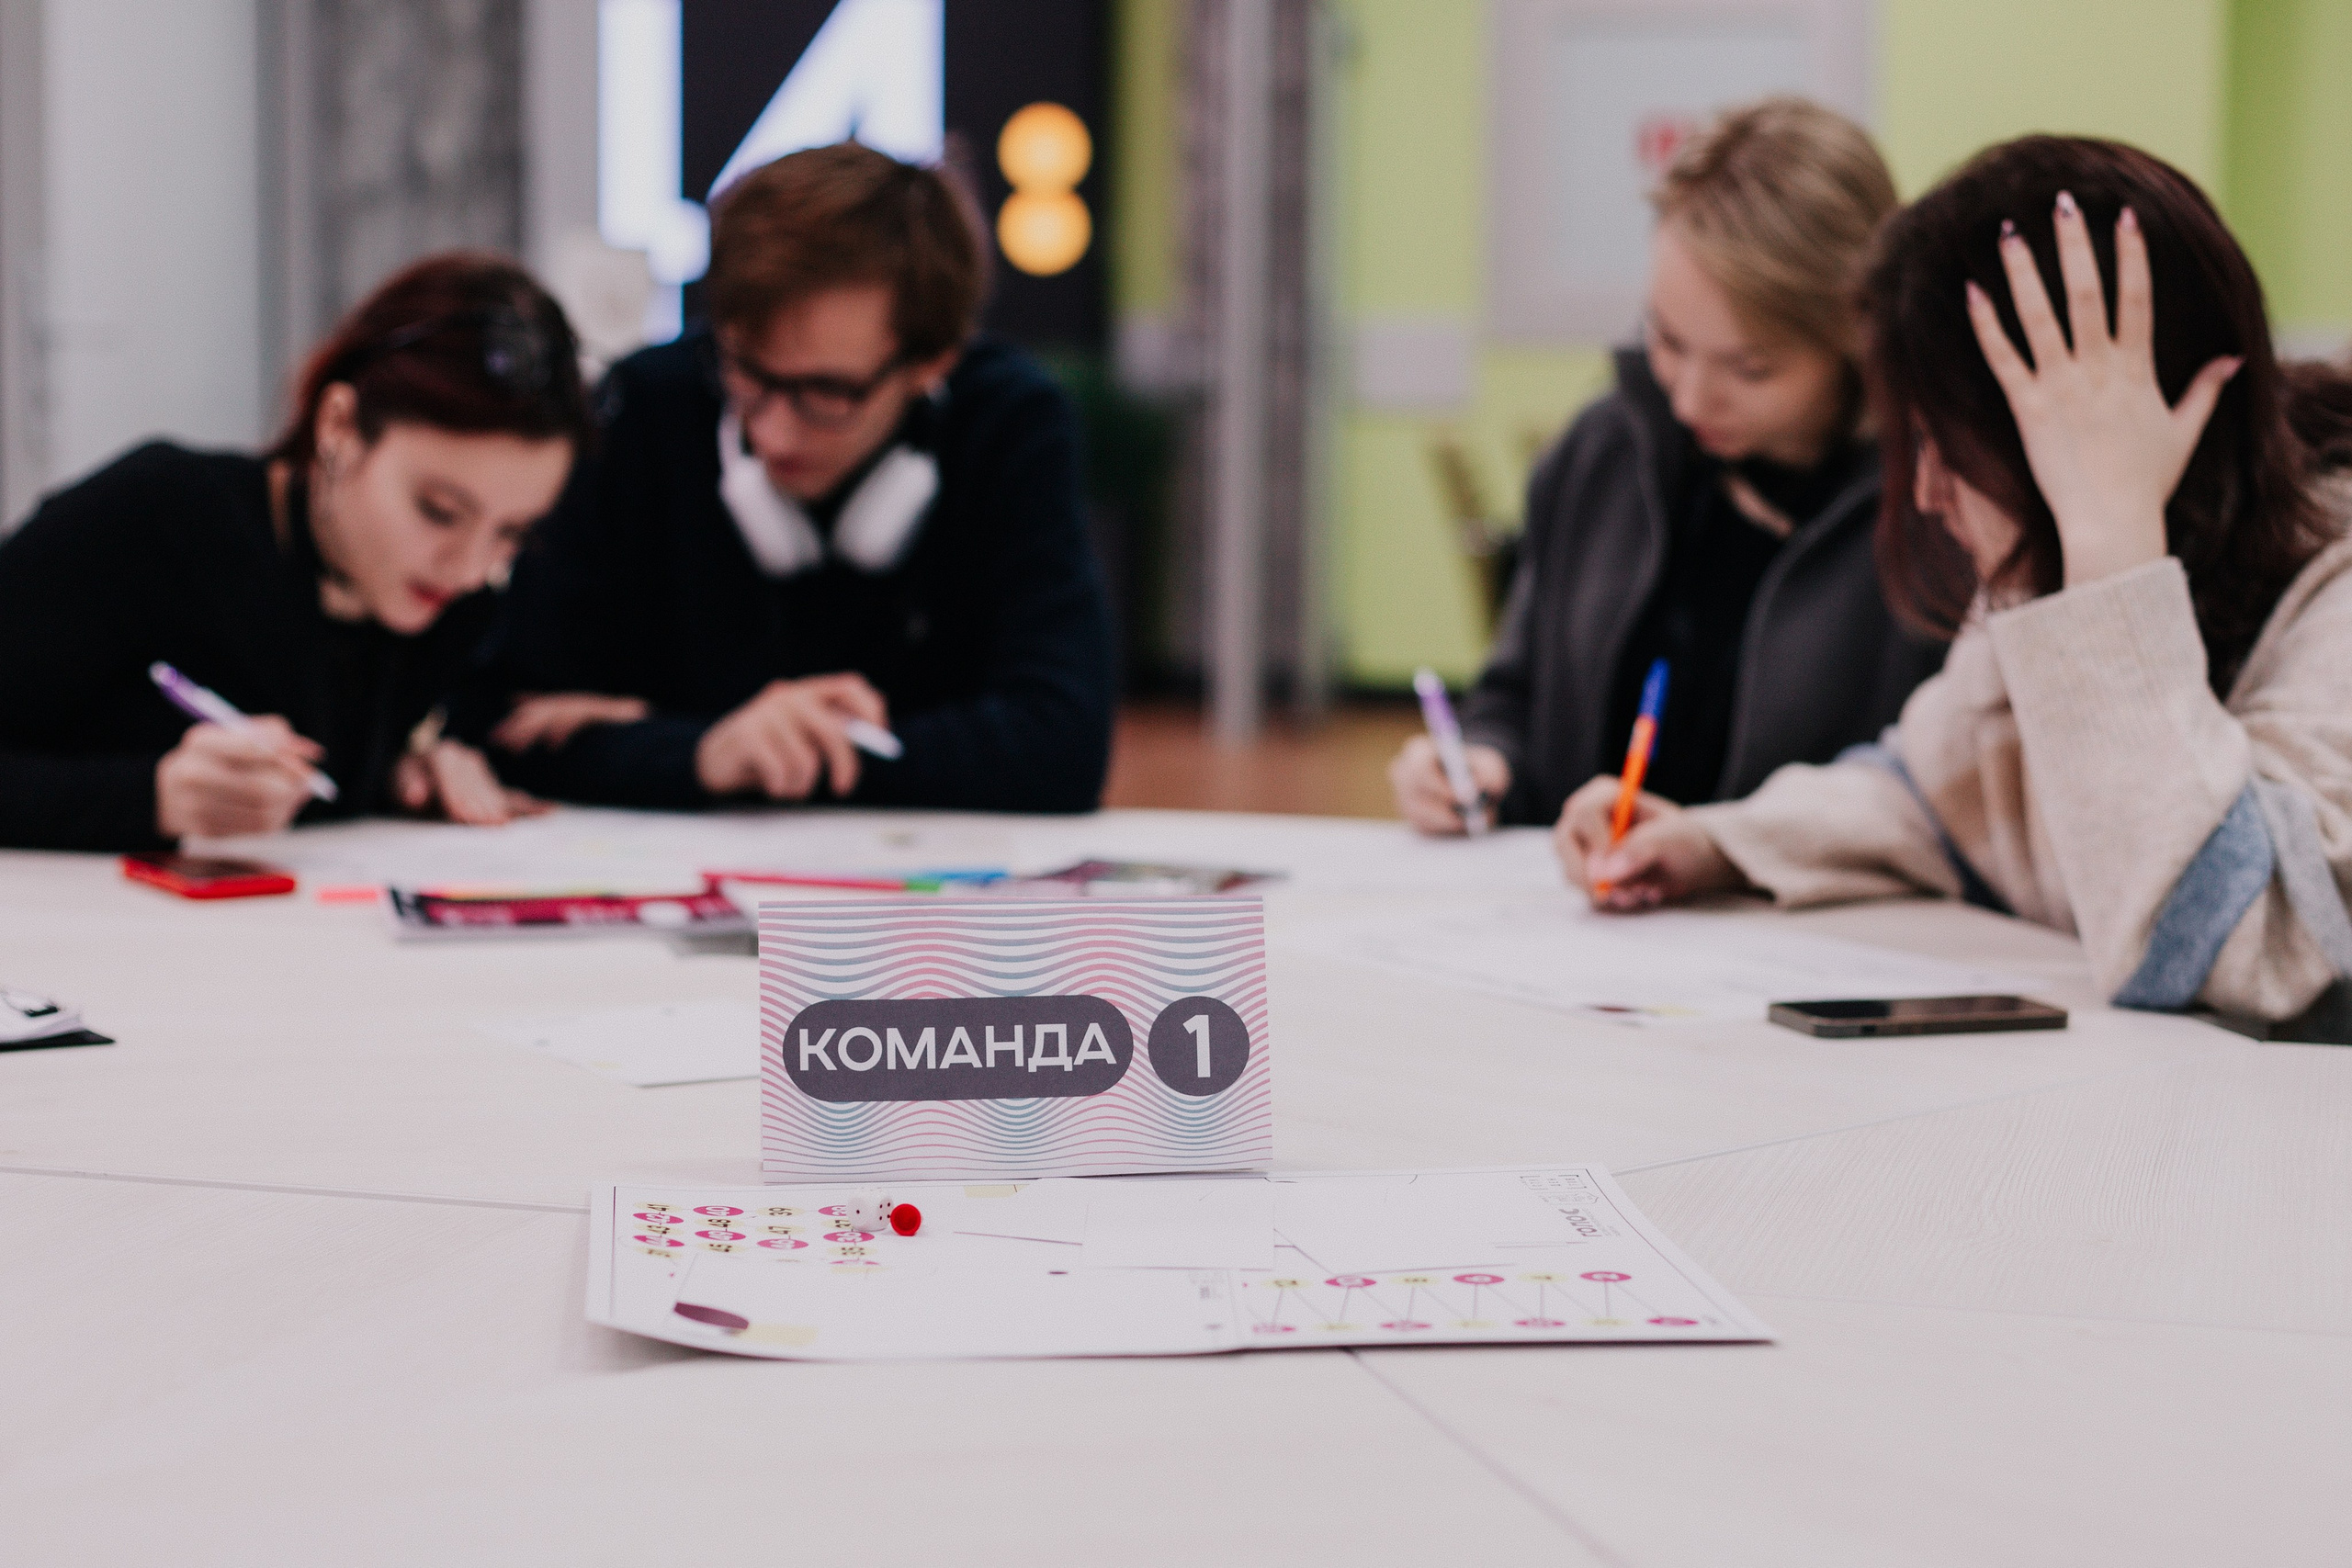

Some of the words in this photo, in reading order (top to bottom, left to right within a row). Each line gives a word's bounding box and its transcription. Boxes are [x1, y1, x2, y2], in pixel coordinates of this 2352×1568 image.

[798, 1022, 1117, 1073] КОМАНДА
[1182, 1014, 1212, 1078] 1
[647, 1203, 671, 1212] 41
[705, 1206, 730, 1216] 40
[768, 1207, 792, 1216] 39
[707, 1218, 731, 1228] 48
